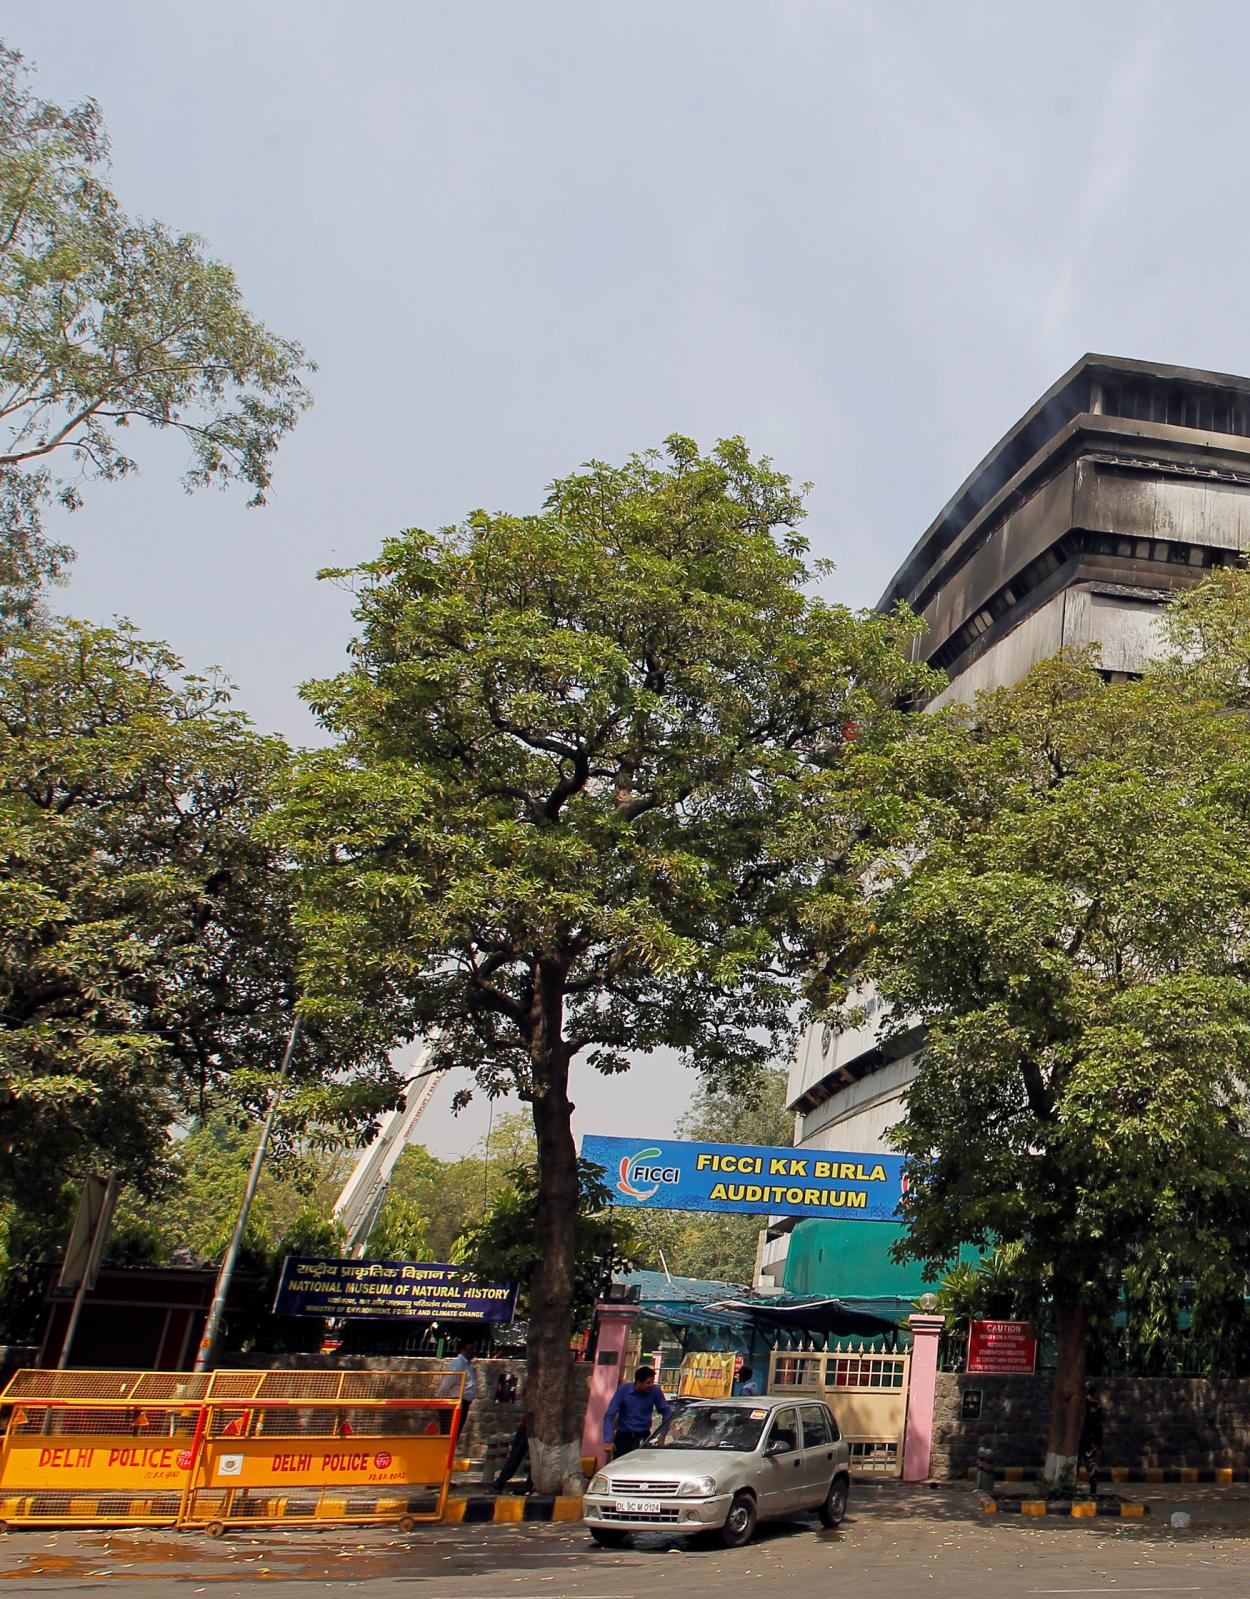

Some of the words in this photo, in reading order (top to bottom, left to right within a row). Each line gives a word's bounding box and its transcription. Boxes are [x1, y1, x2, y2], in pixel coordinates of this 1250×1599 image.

[633, 1166, 680, 1183] FICCI
[696, 1154, 762, 1174] FICCI
[769, 1159, 807, 1177] KK
[814, 1161, 888, 1182] BIRLA
[709, 1182, 868, 1208] AUDITORIUM
[297, 1262, 338, 1278] राष्ट्रीय
[341, 1264, 399, 1280] प्राकृतिक
[401, 1266, 445, 1280] विज्ञान
[288, 1280, 342, 1293] NATIONAL
[345, 1283, 392, 1295] MUSEUM
[395, 1285, 410, 1295] OF
[412, 1285, 460, 1298] NATURAL
[464, 1287, 510, 1299] HISTORY
[986, 1324, 1022, 1333] CAUTION
[38, 1447, 94, 1468] DELHI
[108, 1447, 174, 1468] POLICE
[271, 1454, 313, 1472] DELHI
[321, 1453, 370, 1471] POLICE
